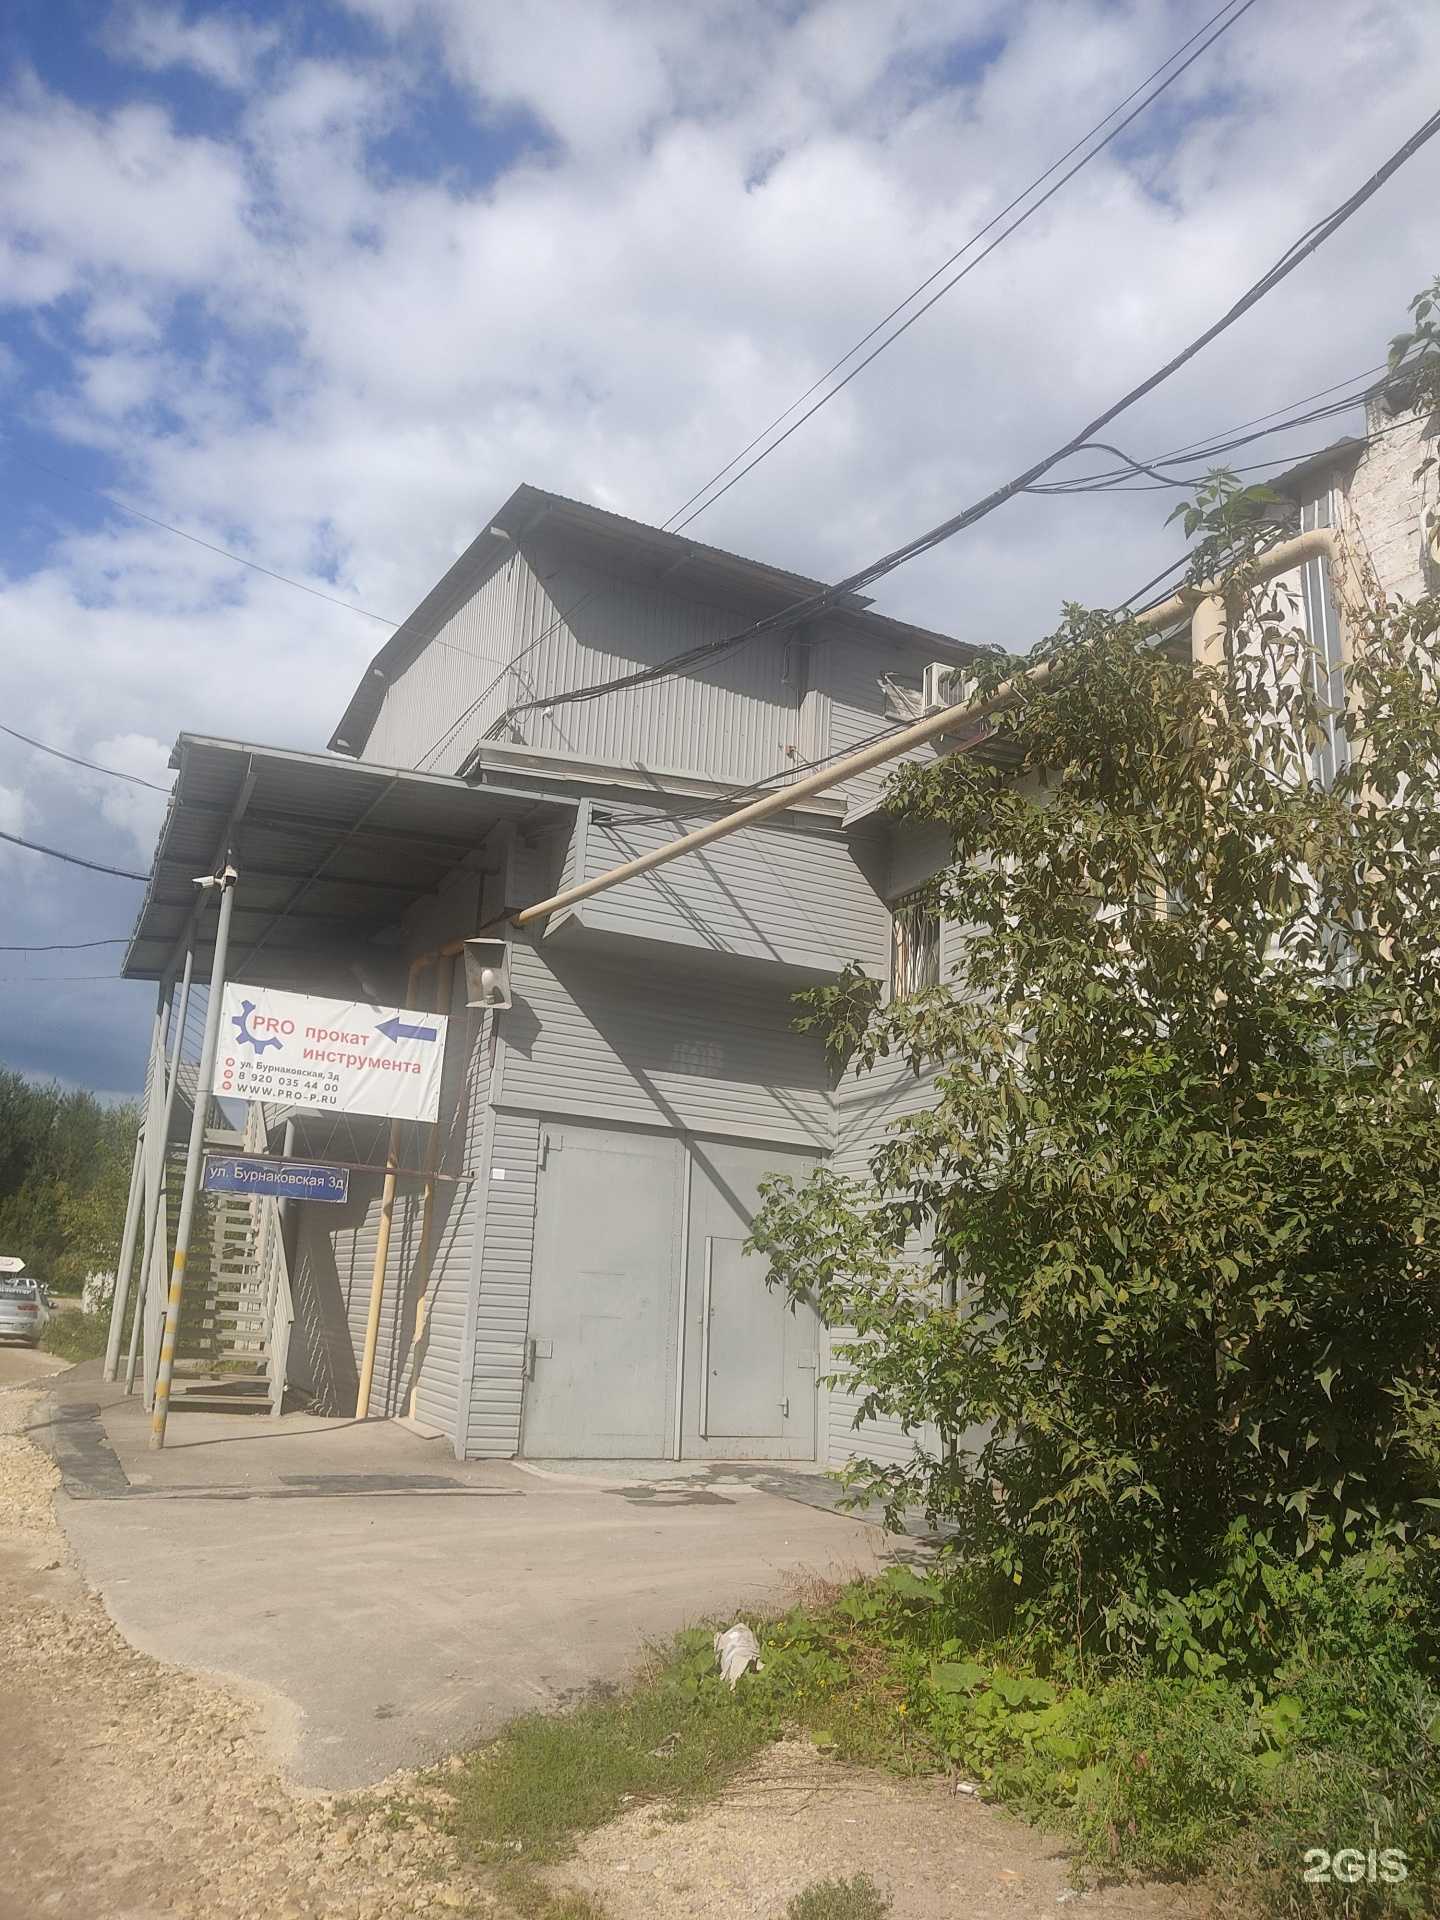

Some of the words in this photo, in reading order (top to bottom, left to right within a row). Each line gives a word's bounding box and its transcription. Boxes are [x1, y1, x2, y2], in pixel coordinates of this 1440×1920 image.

[252, 1015, 295, 1035] PRO
[305, 1026, 369, 1045] прокат
[240, 1061, 254, 1071] ул.
[303, 1047, 421, 1074] инструмента
[238, 1072, 245, 1080] 8
[251, 1073, 273, 1084] 920
[279, 1077, 299, 1088] 035
[304, 1081, 318, 1090] 44
[324, 1083, 338, 1093] 00
[237, 1083, 337, 1105] WWW.PRO-P.RU
[209, 1167, 229, 1179] ул.
[234, 1168, 325, 1186] Бурнаковская
